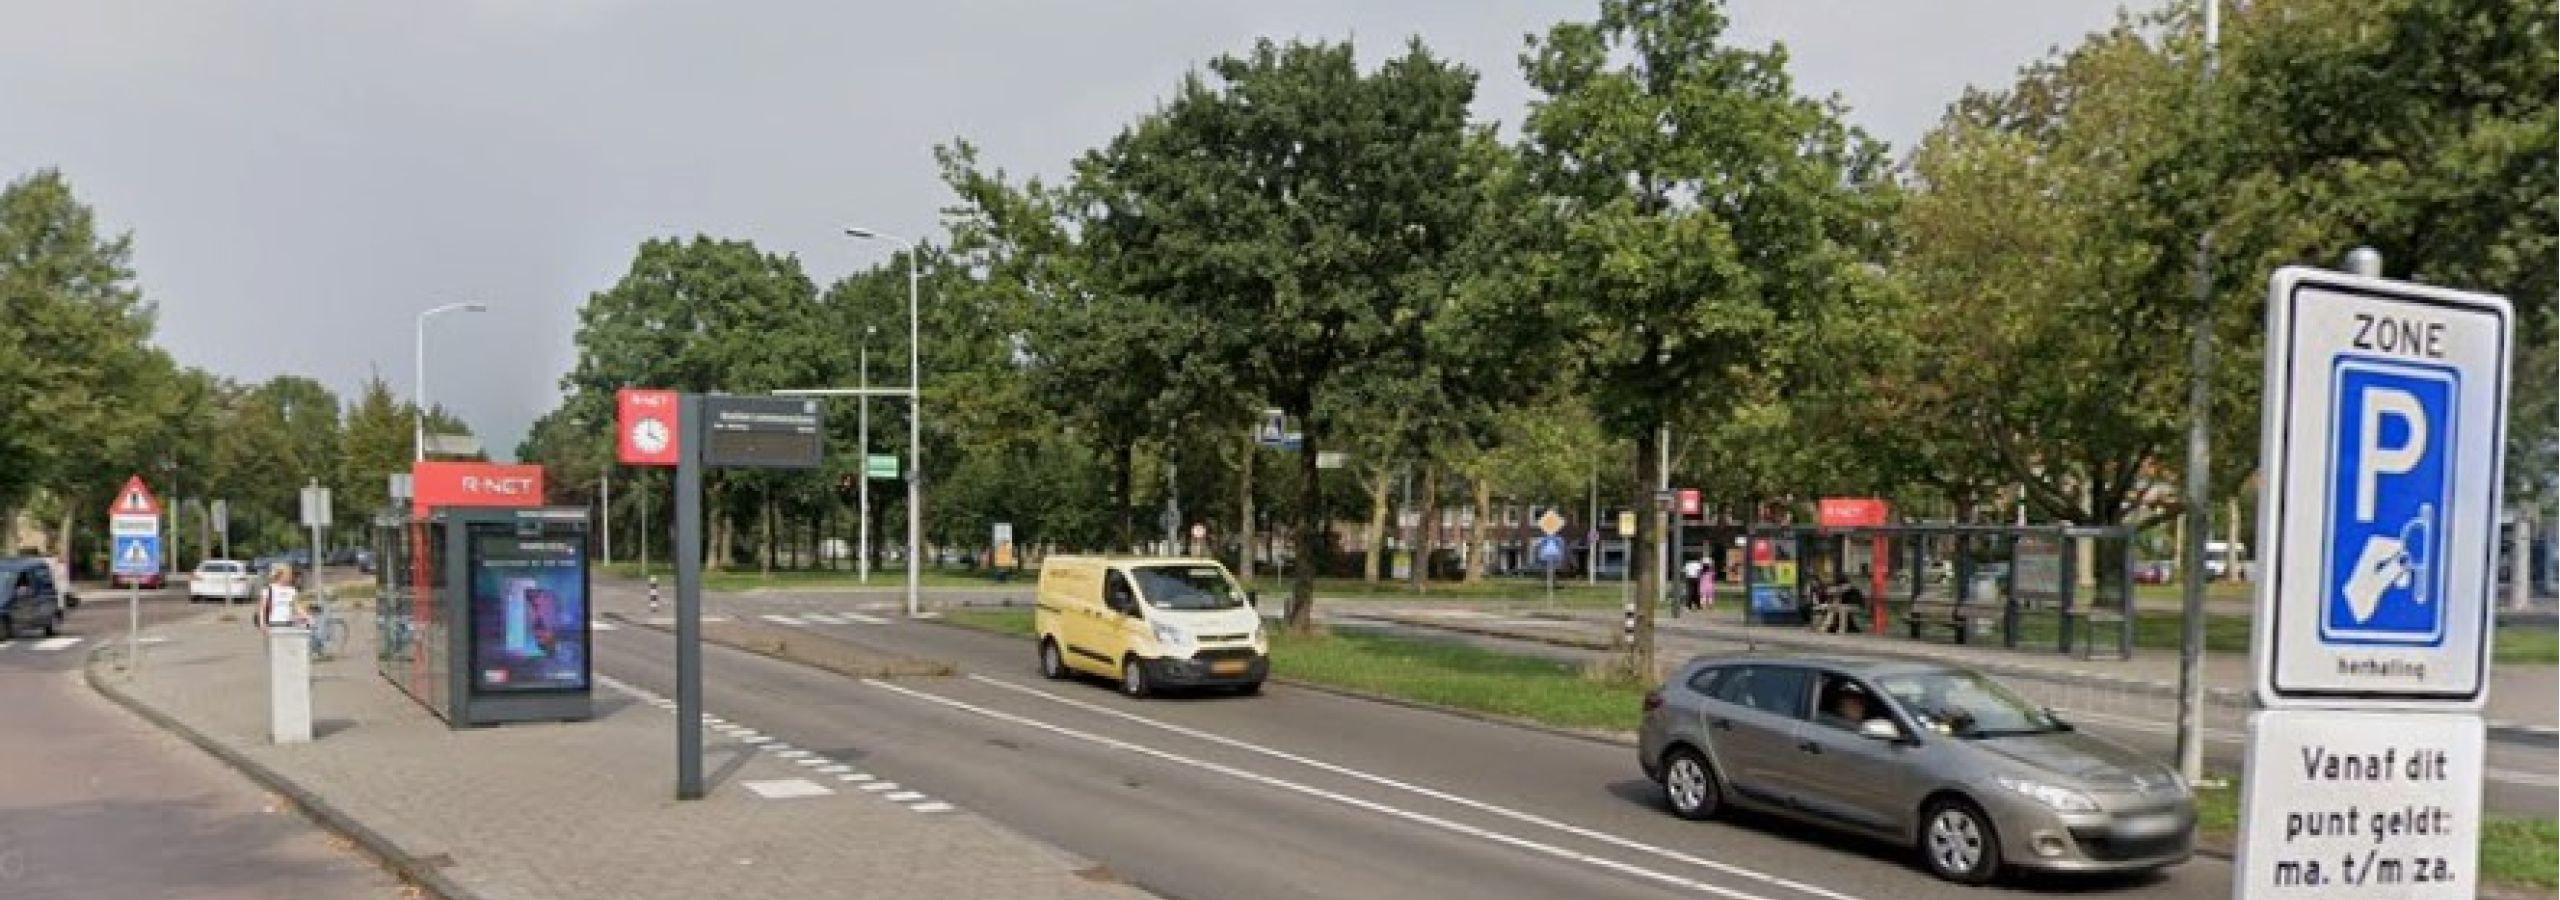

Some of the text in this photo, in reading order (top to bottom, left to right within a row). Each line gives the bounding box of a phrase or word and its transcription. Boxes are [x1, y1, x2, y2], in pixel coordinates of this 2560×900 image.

[2353, 314, 2446, 358] ZONE
[2357, 386, 2427, 522] P
[462, 476, 532, 495] R-NET
[2302, 746, 2448, 780] Vanaf dit
[2287, 806, 2453, 844] punt geldt:
[2273, 850, 2455, 886] ma. t/m za.
